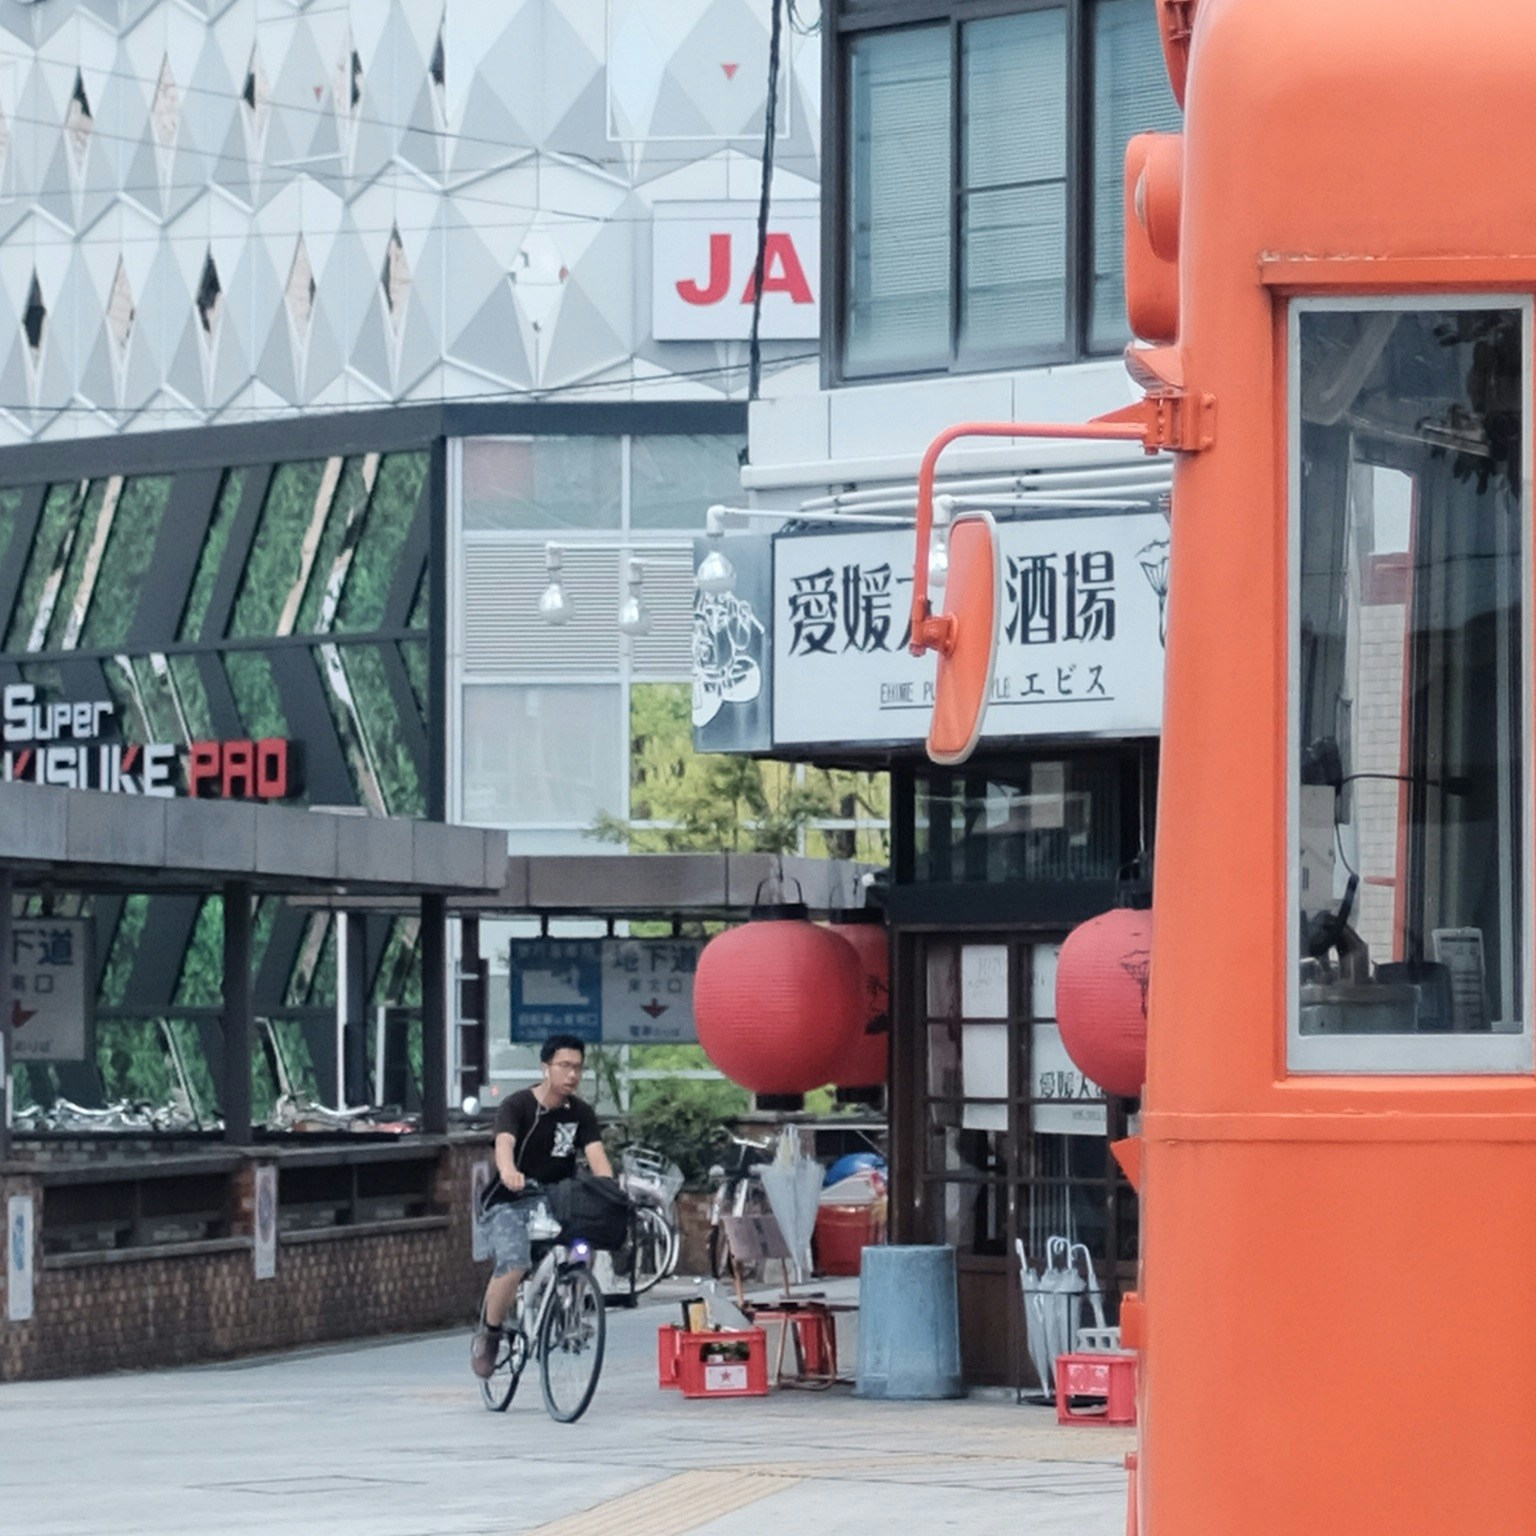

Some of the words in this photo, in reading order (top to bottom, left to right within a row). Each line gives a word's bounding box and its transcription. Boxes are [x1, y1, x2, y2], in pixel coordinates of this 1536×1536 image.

[674, 232, 815, 306] JA
[787, 550, 1116, 657] 愛媛酒場
[1020, 664, 1107, 697] エビス
[4, 683, 113, 742] Super
[189, 737, 288, 800] PAO
